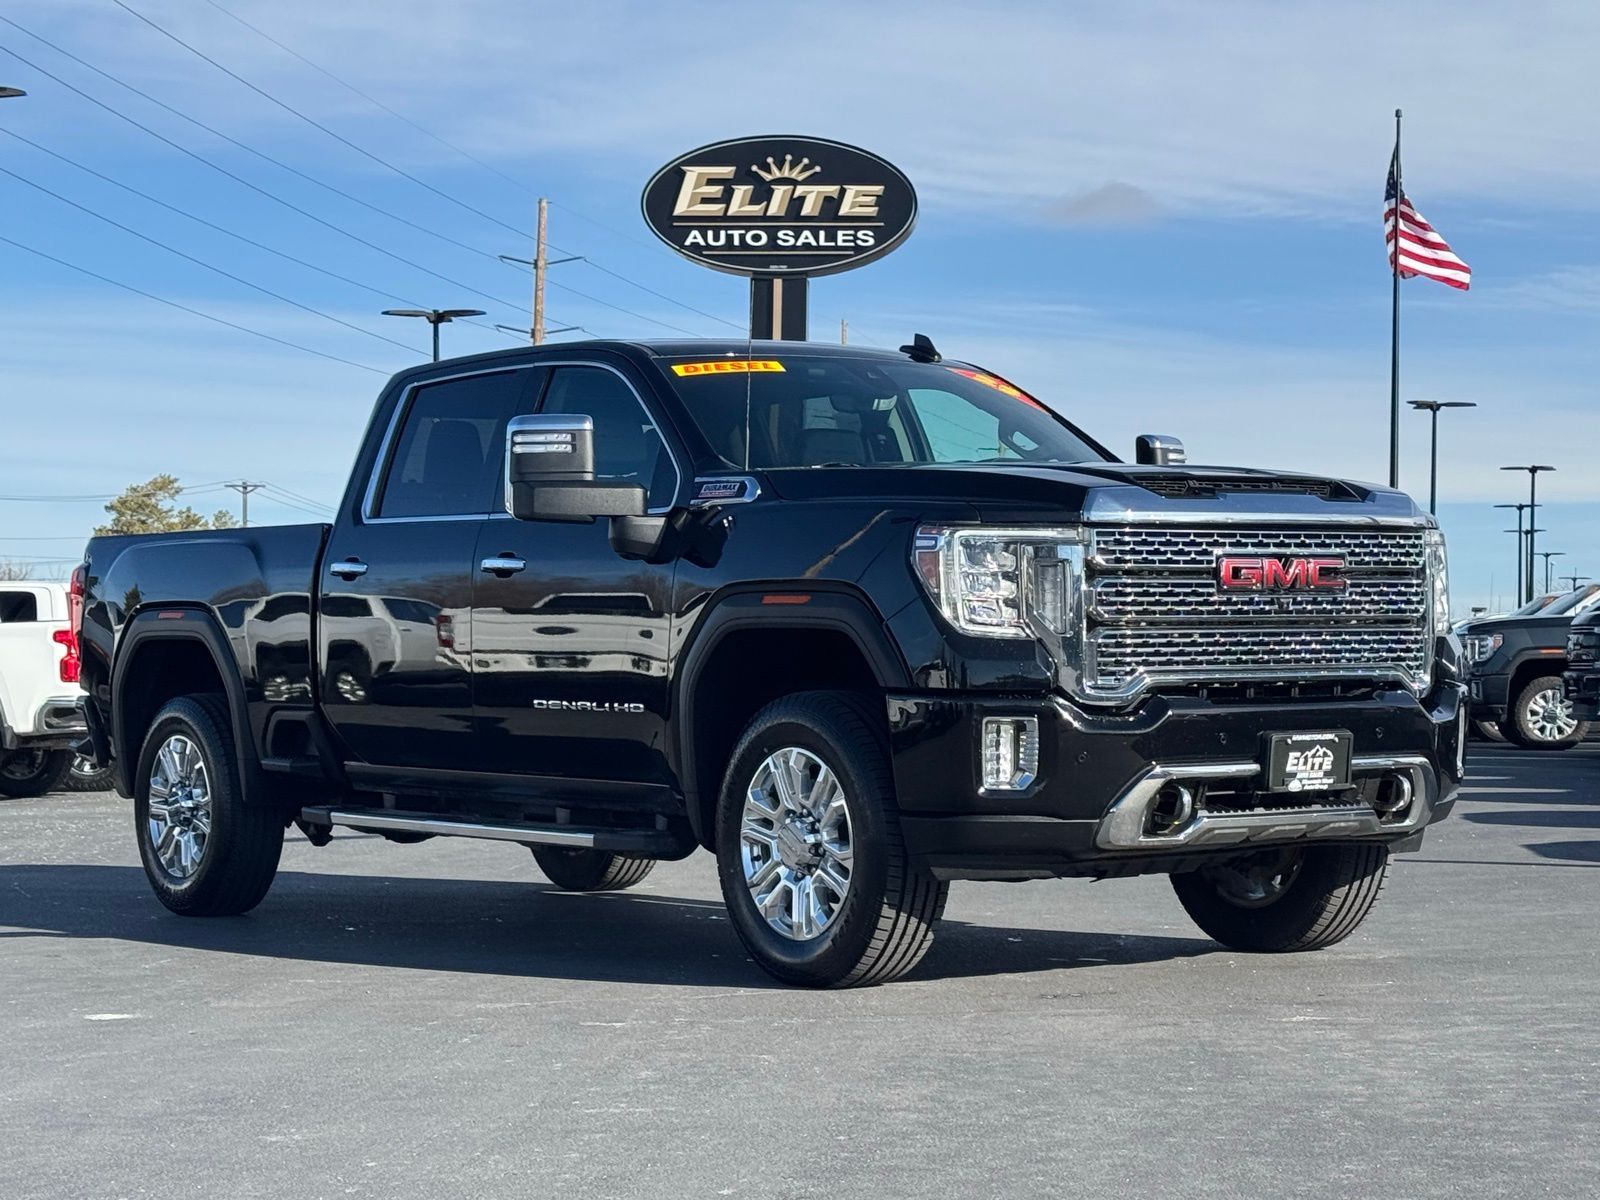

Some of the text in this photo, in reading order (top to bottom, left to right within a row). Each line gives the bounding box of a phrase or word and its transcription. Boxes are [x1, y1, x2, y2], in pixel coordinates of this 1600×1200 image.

[672, 166, 886, 217] ELITE
[684, 229, 876, 247] AUTO SALES
[683, 362, 777, 374] DIESEL
[1219, 557, 1346, 588] GMC
[533, 699, 645, 713] DENALI HD
[1286, 752, 1334, 773] ELITE
